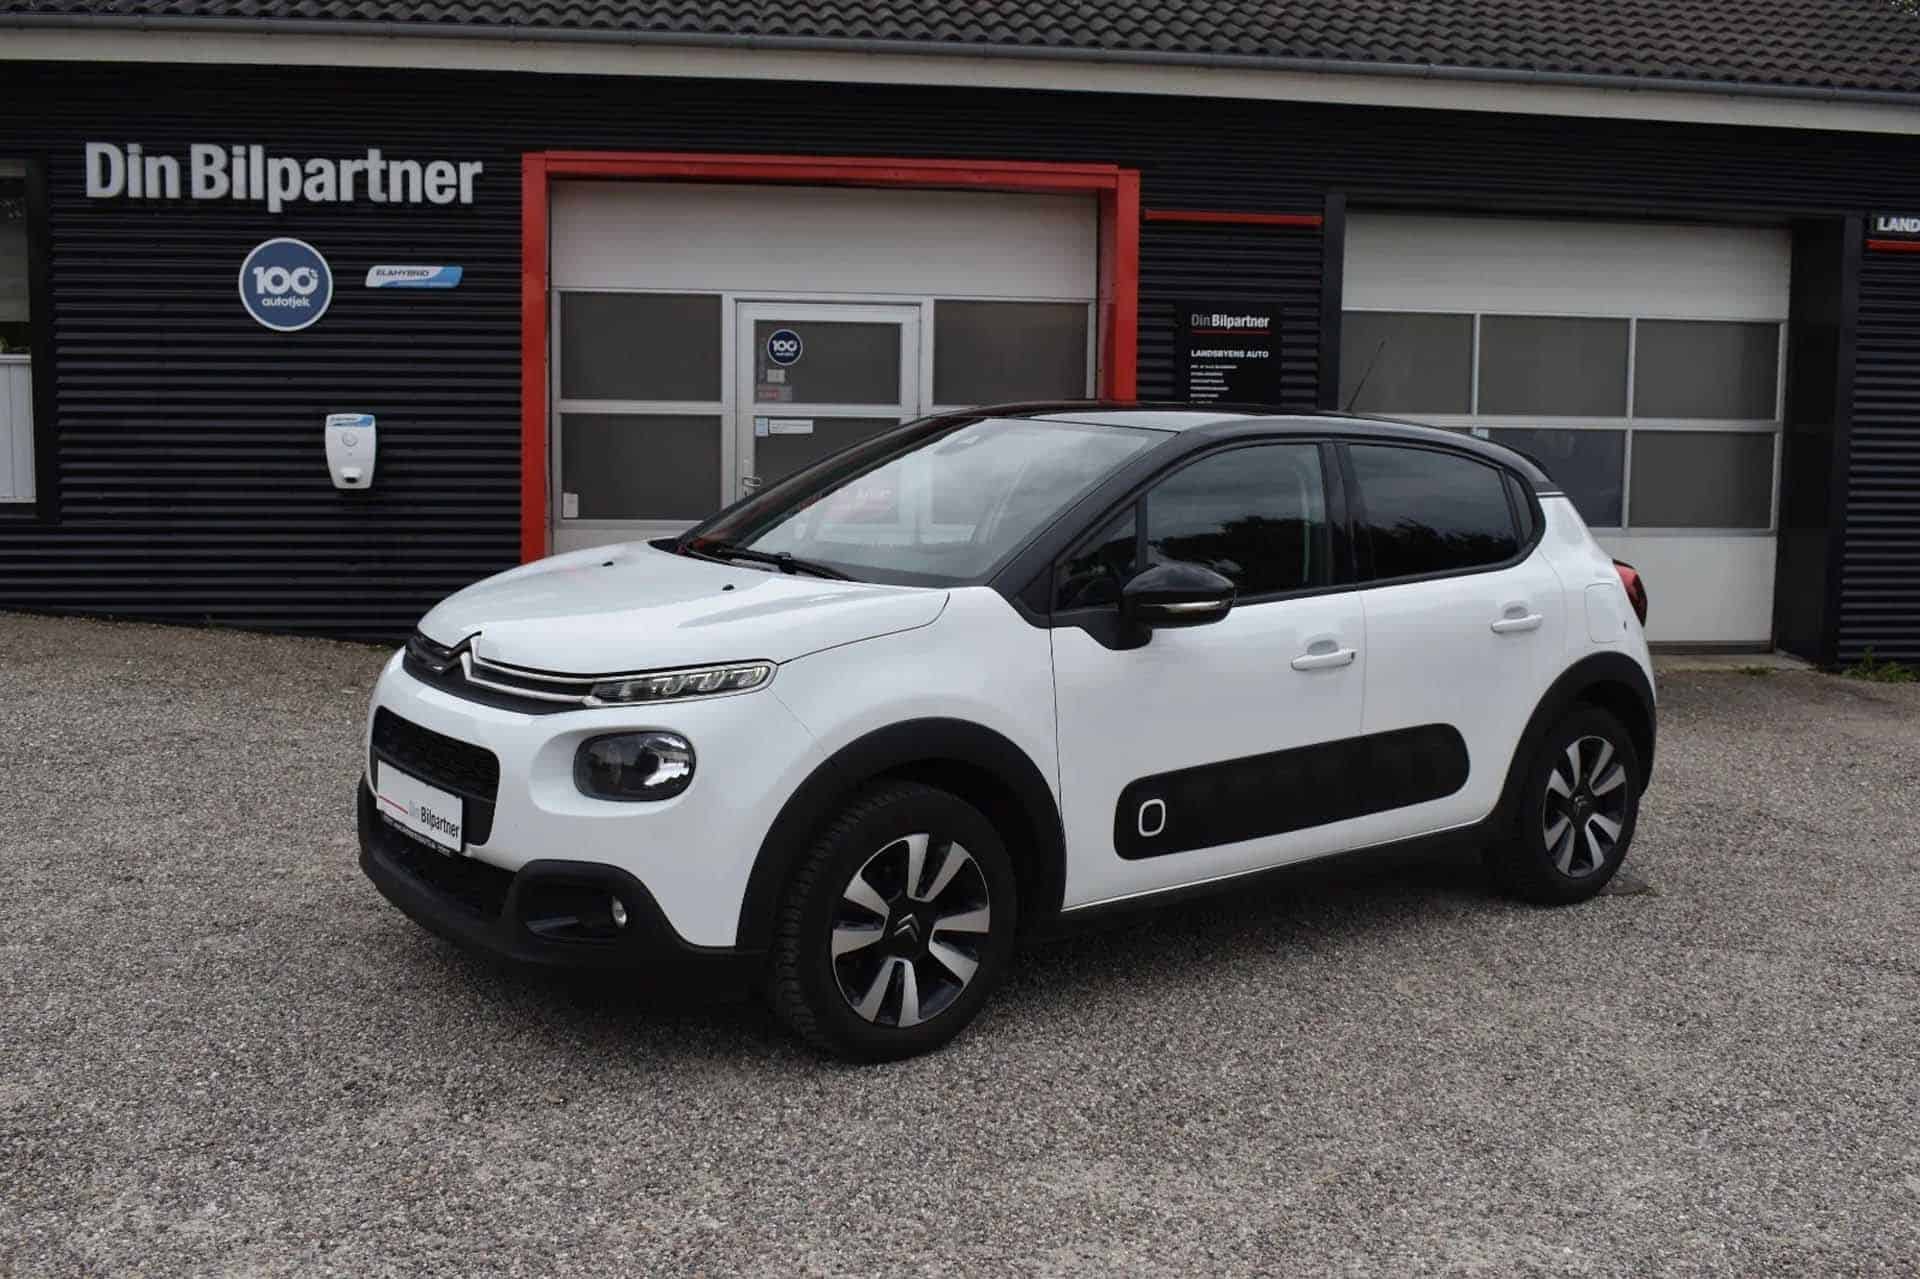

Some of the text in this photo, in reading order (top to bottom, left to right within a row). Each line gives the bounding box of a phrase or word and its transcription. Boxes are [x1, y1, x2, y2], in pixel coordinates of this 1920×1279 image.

[86, 142, 483, 213] Din Bilpartner
[262, 296, 310, 308] autotjek
[1191, 313, 1270, 329] Din Bilpartner
[1246, 350, 1269, 358] AUTO
[420, 806, 460, 838] Bilpartner
